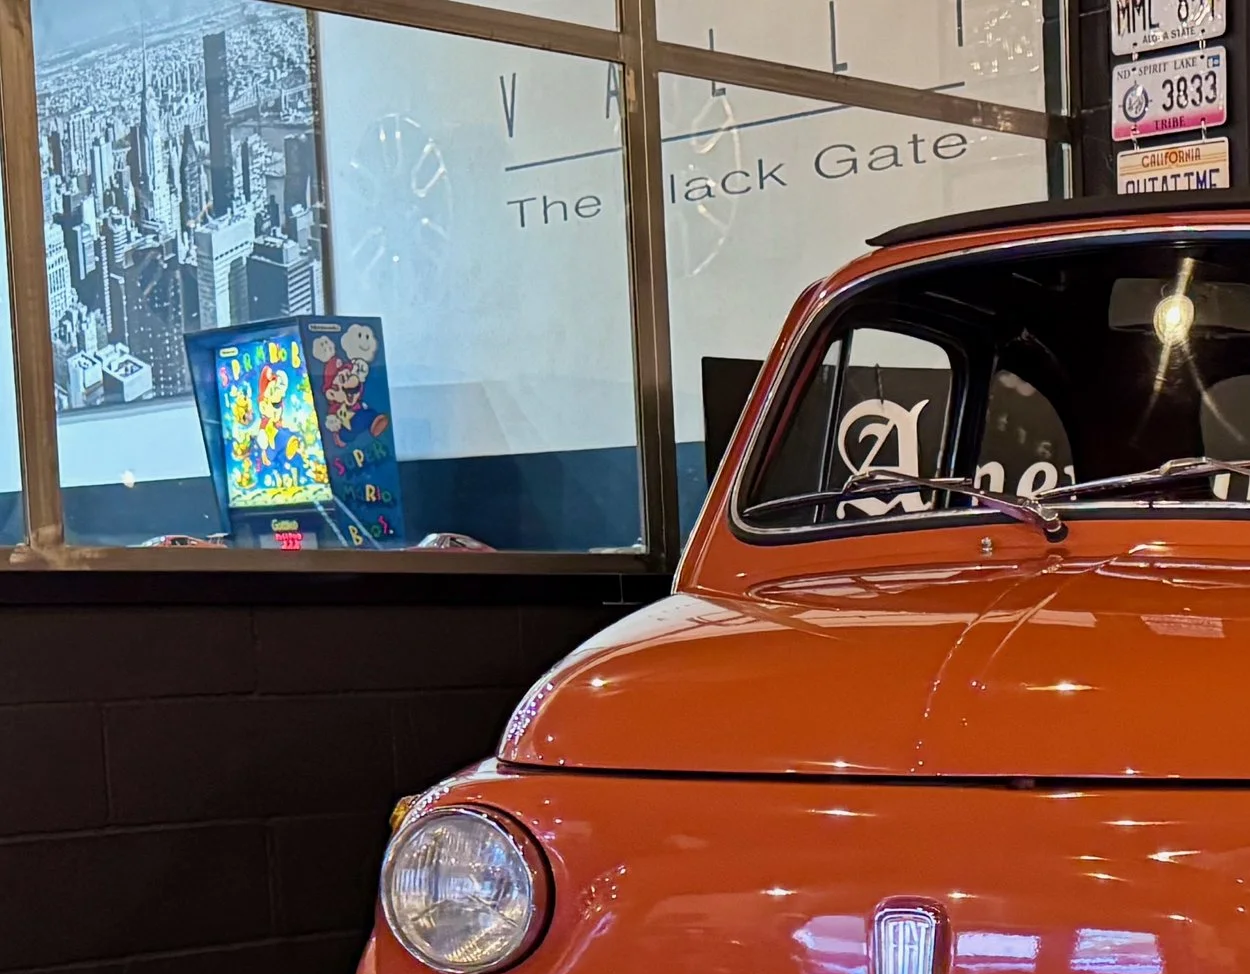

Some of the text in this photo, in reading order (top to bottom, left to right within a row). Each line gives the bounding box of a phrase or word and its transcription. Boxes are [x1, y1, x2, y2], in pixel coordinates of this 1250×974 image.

[1142, 27, 1196, 44] ALOA STATE
[1117, 57, 1198, 81] ND SPIRIT LAKE
[1162, 70, 1217, 112] 3833
[1154, 116, 1185, 131] TRIBE
[1142, 147, 1201, 168] CALIFORNIA
[506, 131, 968, 229] The lack Gate
[348, 514, 395, 546] BOS.
